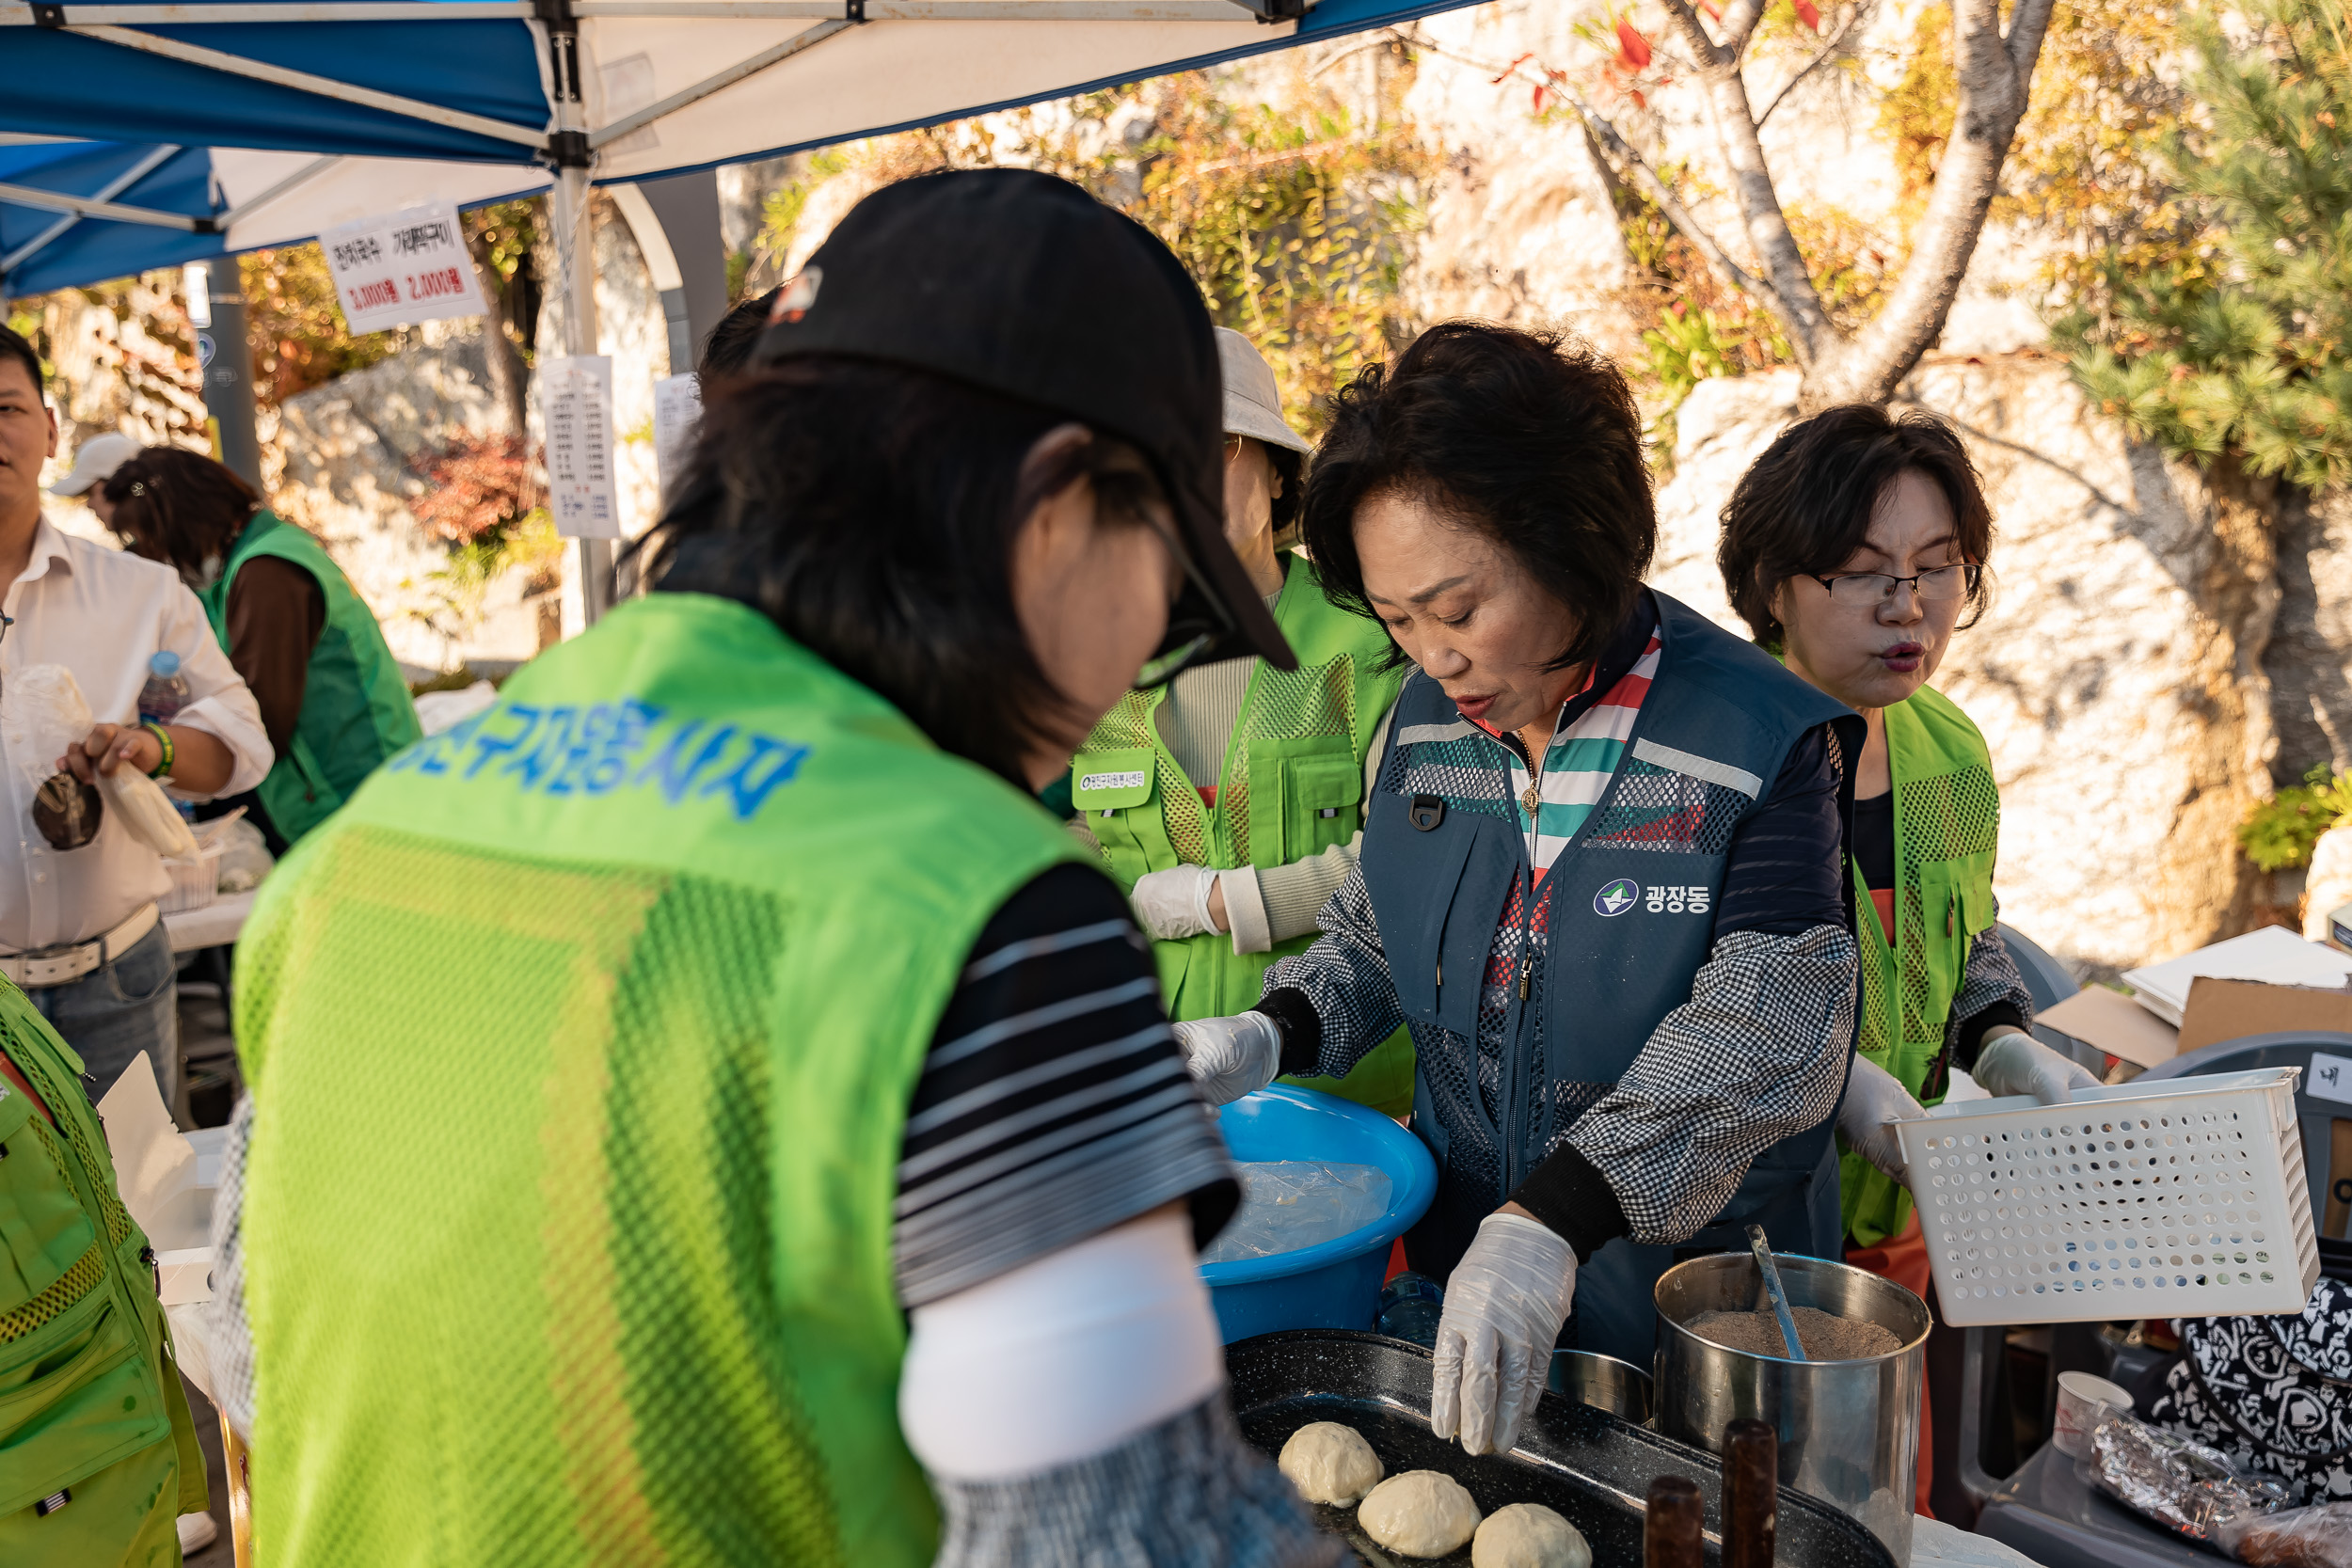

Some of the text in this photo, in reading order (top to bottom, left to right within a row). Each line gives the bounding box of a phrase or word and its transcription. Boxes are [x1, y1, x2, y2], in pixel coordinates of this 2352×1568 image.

[406, 266, 465, 300] 2,000원
[1091, 772, 1143, 787] 광진구자원봉사센터
[1645, 886, 1710, 913] 광장동
